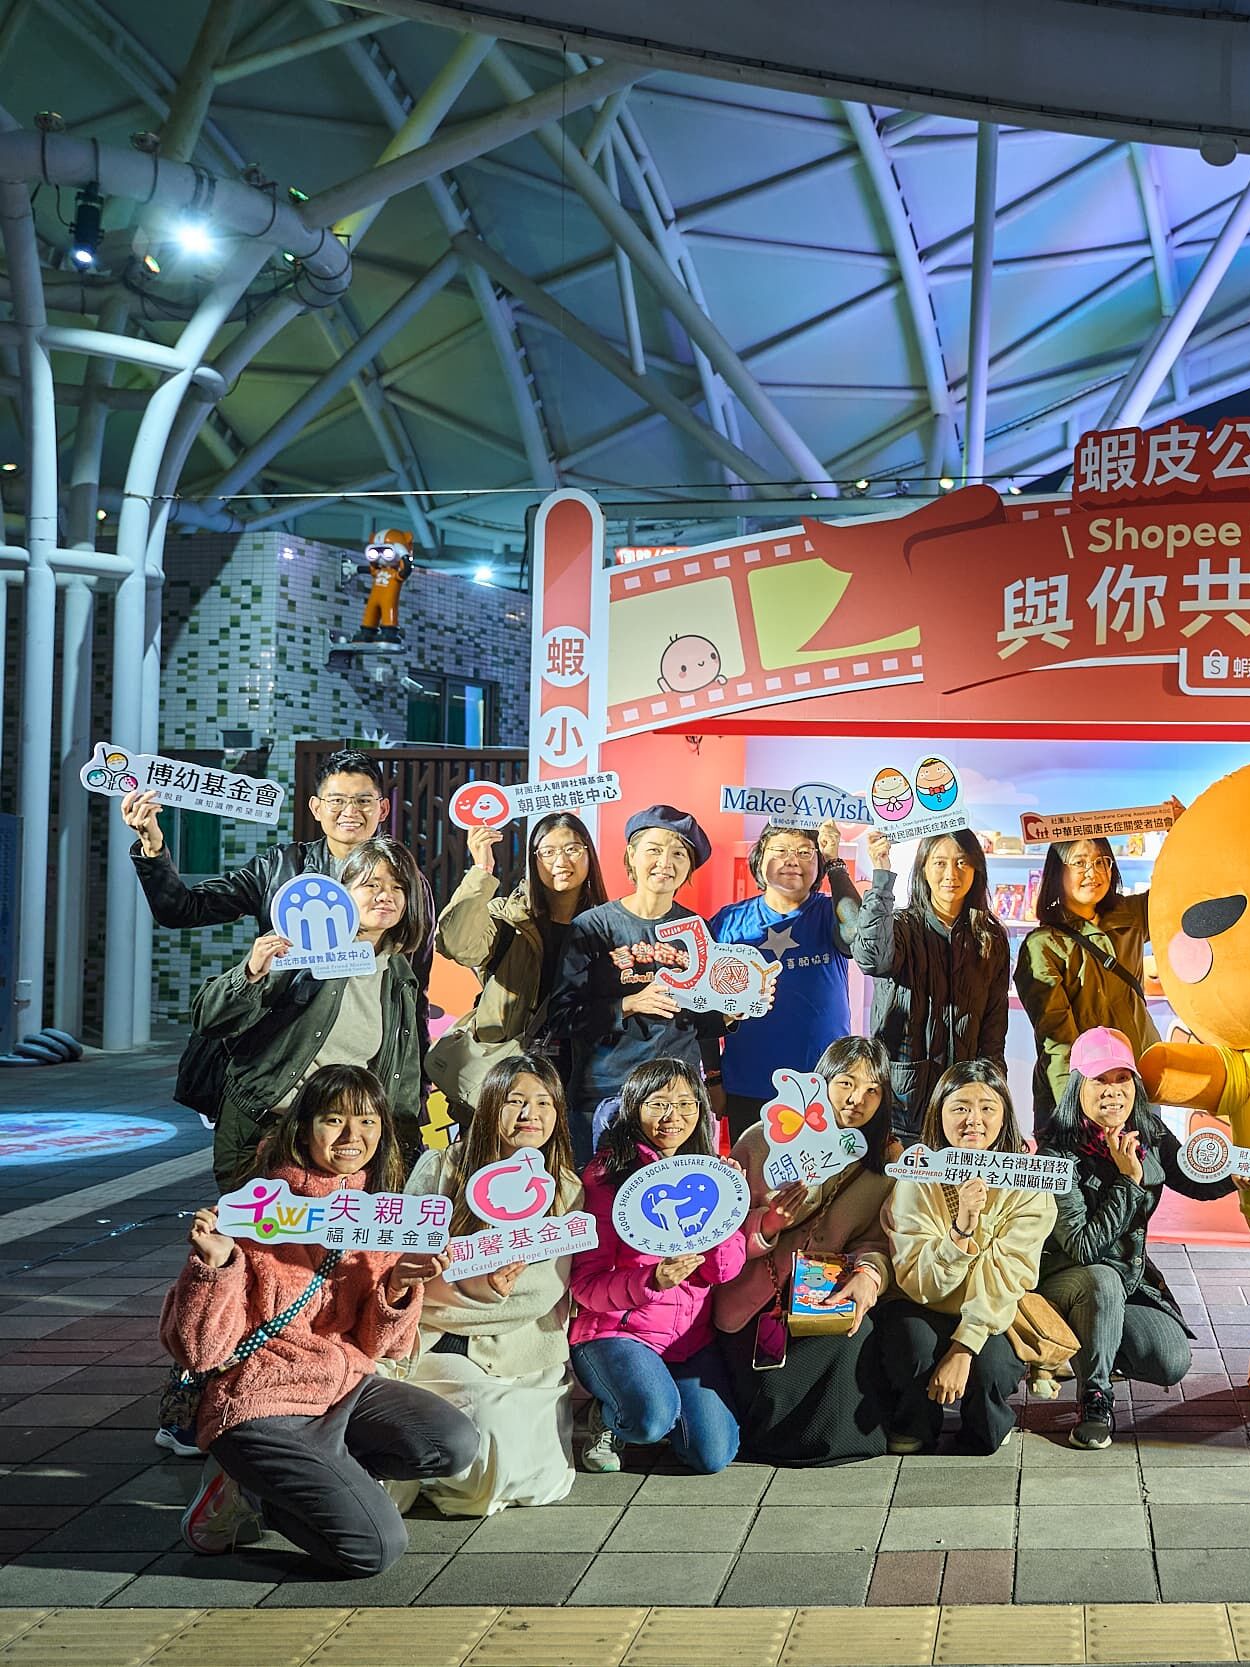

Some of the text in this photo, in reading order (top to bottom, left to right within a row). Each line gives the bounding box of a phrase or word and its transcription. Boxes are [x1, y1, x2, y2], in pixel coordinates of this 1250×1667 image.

[1087, 517, 1242, 561] Shopee
[147, 761, 280, 807] 博幼基金會
[517, 786, 618, 813] 朝興啟能中心
[723, 785, 871, 822] Make-A-Wish
[945, 1150, 1069, 1174] 社團法人台灣基督教
[620, 1176, 644, 1207] SHEPHERD
[645, 1163, 670, 1179] SOCIAL
[673, 1158, 705, 1167] WELFARE
[708, 1161, 743, 1194] FOUNDATION
[328, 1194, 446, 1227] 失親兒
[326, 1227, 445, 1247] 福利基金會
[450, 1216, 589, 1263] 勵馨基金會
[452, 1240, 592, 1277] The Garden of Hope Foundation
